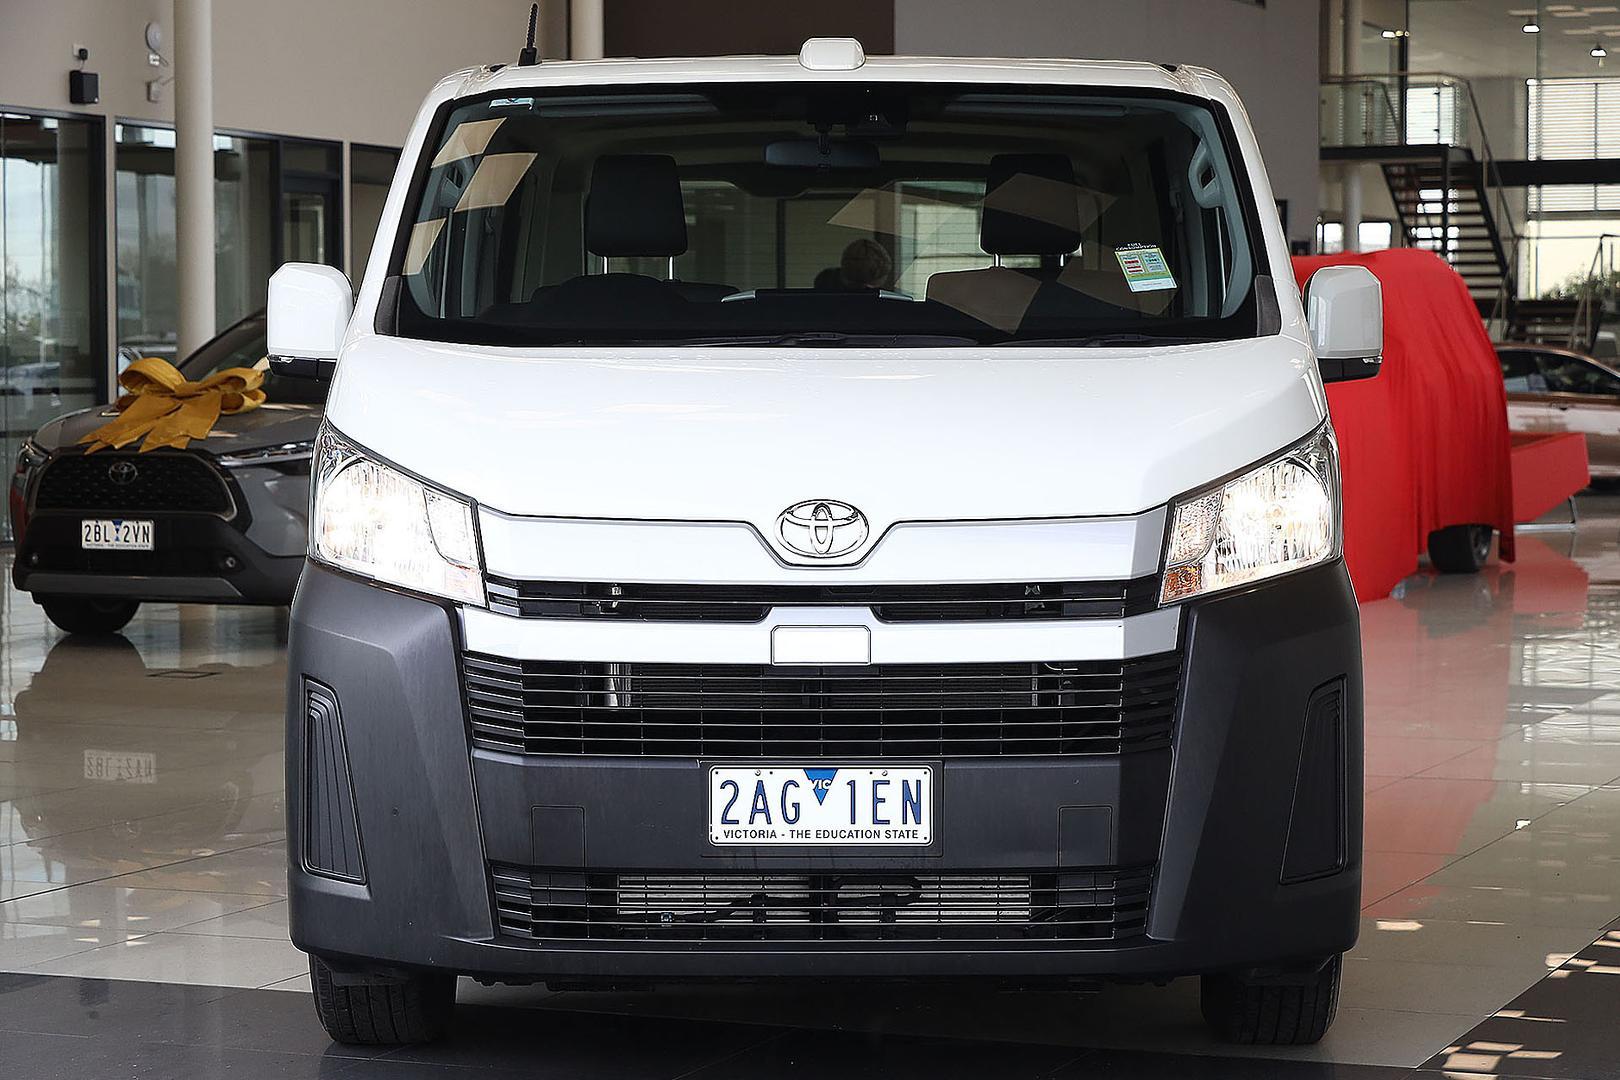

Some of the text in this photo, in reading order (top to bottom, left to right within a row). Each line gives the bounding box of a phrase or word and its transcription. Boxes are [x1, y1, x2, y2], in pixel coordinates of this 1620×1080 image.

[84, 524, 150, 543] 2BL 2YN
[719, 779, 922, 825] 2AG 1EN
[723, 829, 778, 839] VICTORIA
[790, 829, 811, 839] THE
[815, 829, 881, 839] EDUCATION
[884, 829, 919, 839] STATE
